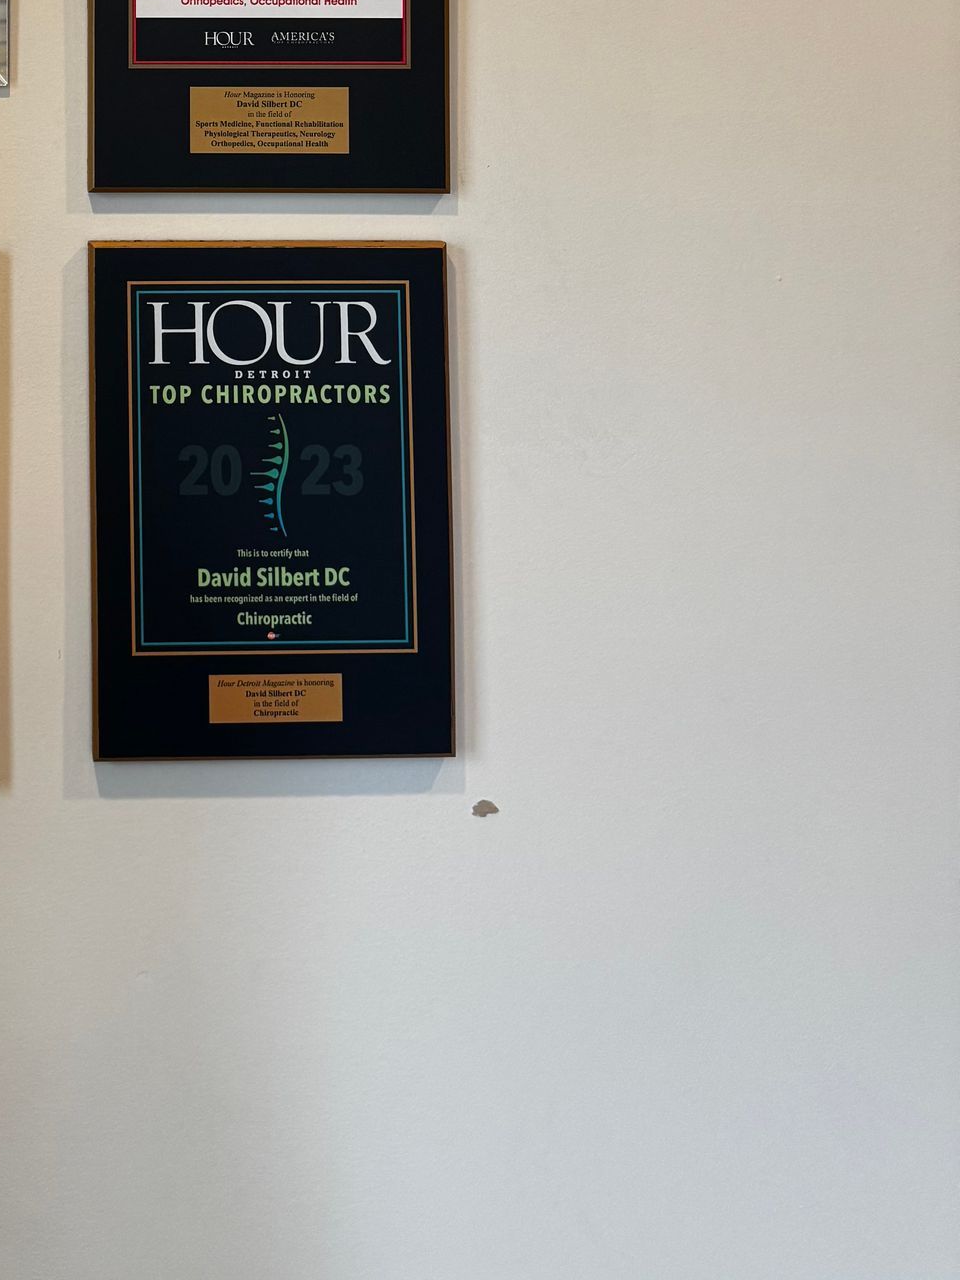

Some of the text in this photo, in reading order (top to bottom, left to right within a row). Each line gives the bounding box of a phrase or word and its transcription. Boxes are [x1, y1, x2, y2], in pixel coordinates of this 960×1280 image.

[205, 31, 255, 46] HOUR
[271, 31, 335, 42] AMERICA'S
[147, 300, 392, 365] HOUR
[235, 370, 312, 379] DETROIT
[149, 385, 390, 404] TOP CHIROPRACTORS
[178, 444, 364, 496] 20 23
[237, 549, 252, 557] This
[270, 549, 292, 558] certify
[294, 548, 309, 556] that
[198, 567, 350, 587] David Silbert DC
[190, 594, 202, 602] has
[205, 594, 222, 602] been
[224, 593, 263, 604] recognized
[285, 593, 308, 603] expert
[310, 593, 317, 601] in
[319, 593, 331, 601] the
[332, 593, 349, 601] field
[351, 592, 358, 601] of
[237, 612, 312, 628] Chiropractic
